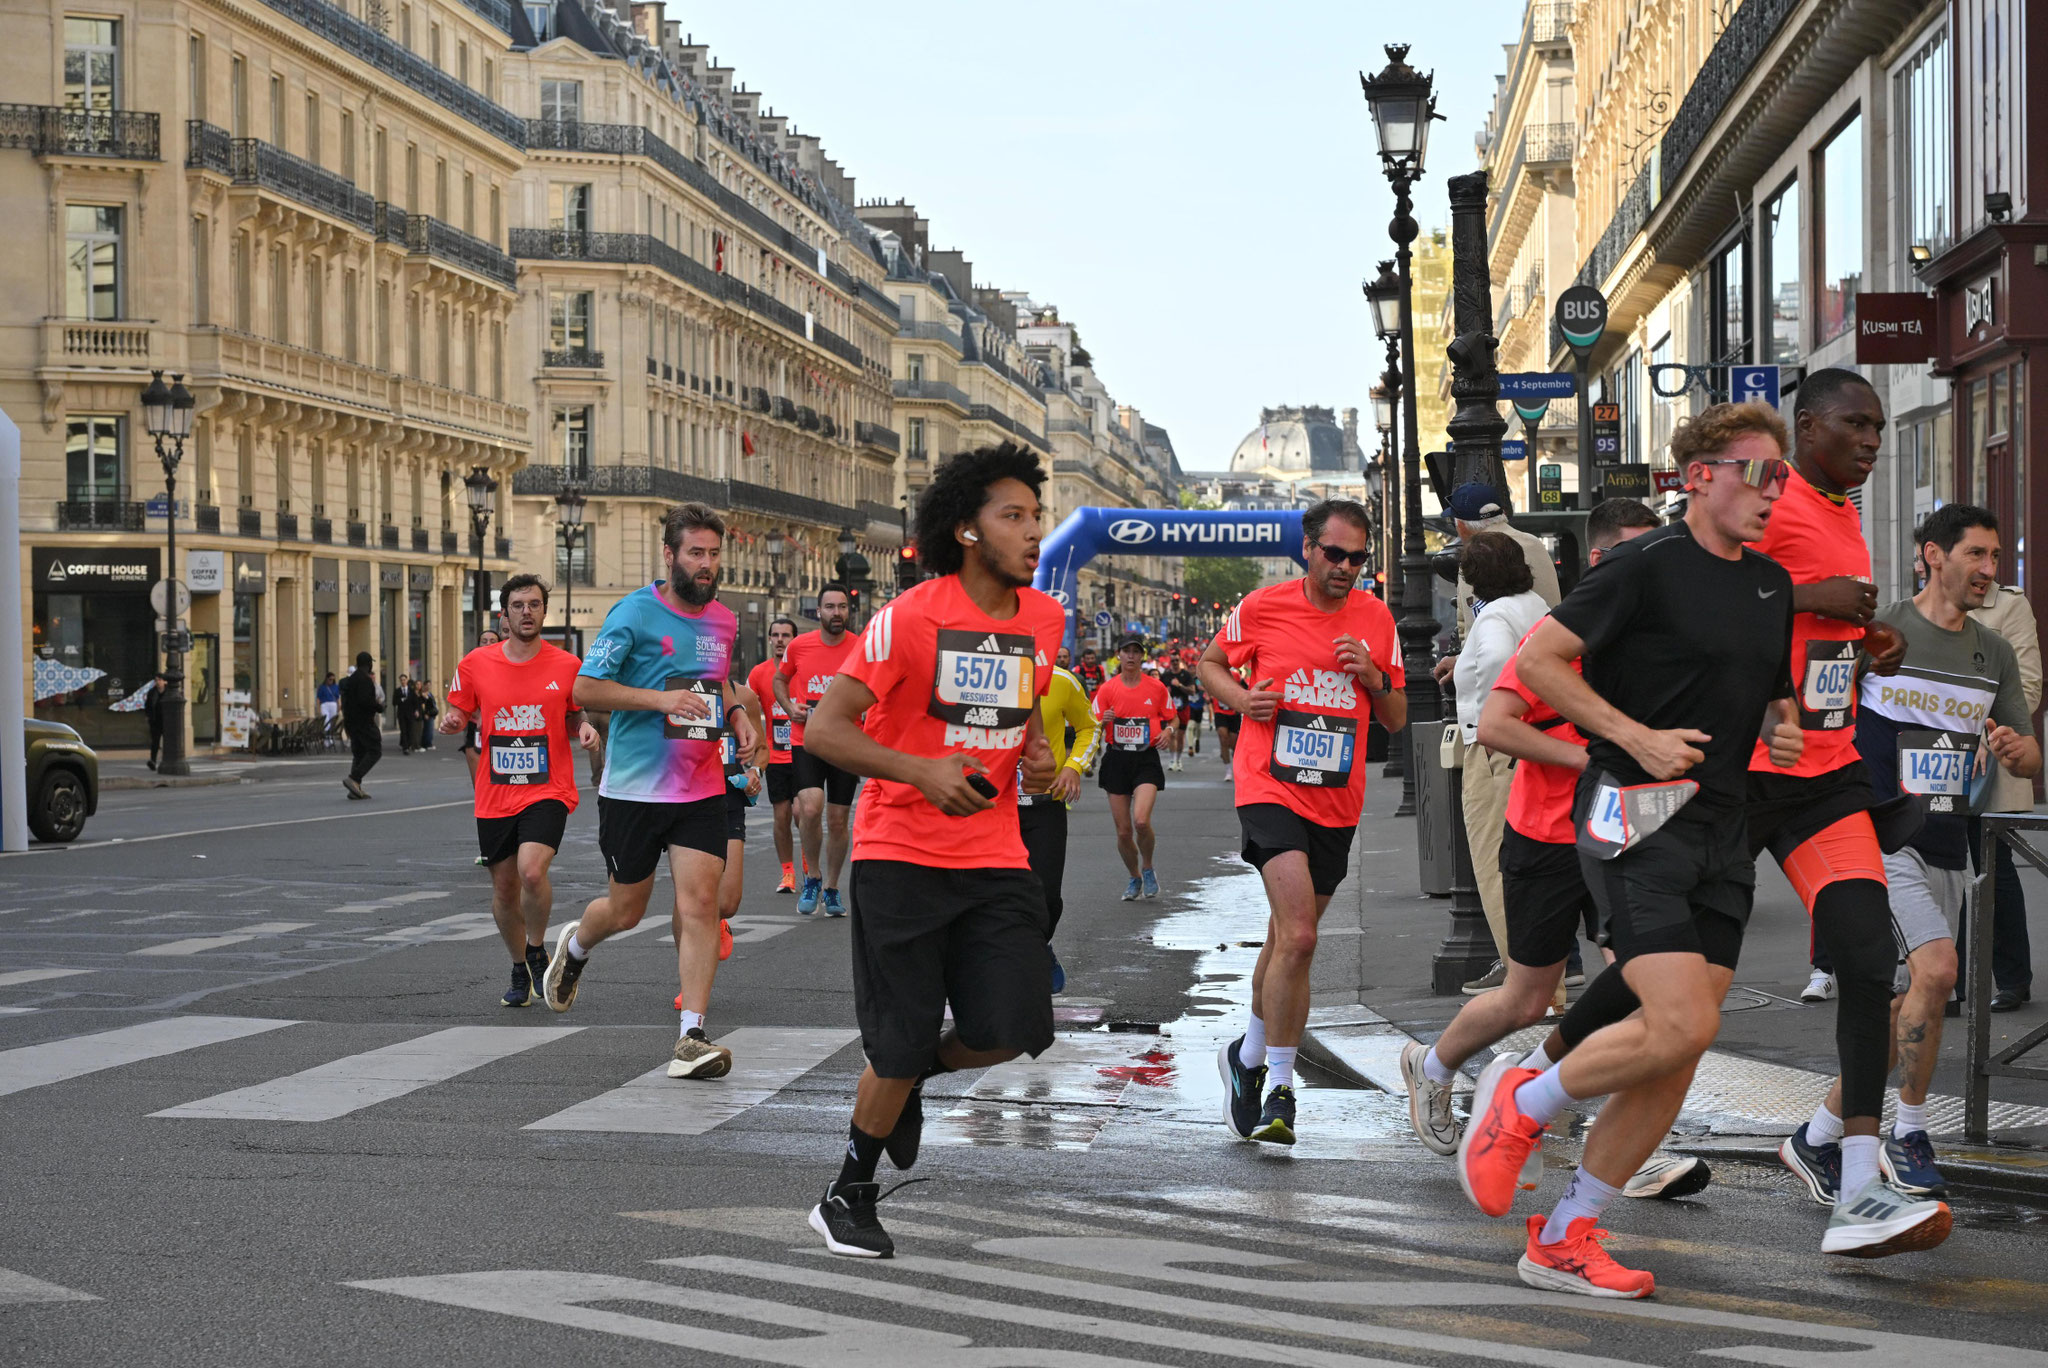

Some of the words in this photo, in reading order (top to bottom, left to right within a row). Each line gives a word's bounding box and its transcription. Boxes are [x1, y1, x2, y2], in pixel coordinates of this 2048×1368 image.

[1564, 300, 1600, 319] BUS
[1862, 320, 1898, 335] KUSMI
[1901, 320, 1923, 335] TEA
[1512, 381, 1519, 389] 4
[1521, 380, 1571, 392] Septembre
[1597, 406, 1615, 420] 27
[1597, 438, 1616, 452] 95
[1543, 467, 1557, 477] 21
[1543, 491, 1559, 502] 68
[1162, 523, 1281, 543] HYUNDAI
[67, 564, 110, 575] COFFEE
[111, 564, 148, 575] HOUSE
[954, 655, 1007, 691] 5576
[1313, 669, 1357, 690] 10K
[959, 691, 999, 704] NESSWESS
[1284, 683, 1357, 710] PARIS
[1881, 686, 1940, 713] PARIS
[511, 704, 546, 720] 10K
[978, 707, 999, 721] 10K
[494, 717, 546, 731] PARIS
[963, 713, 999, 727] PARIS
[1824, 715, 1844, 728] PARIS
[687, 731, 708, 740] PARIS
[944, 722, 1026, 750] PARIS
[1116, 726, 1141, 738] 18009
[1286, 729, 1335, 759] 13051
[496, 751, 535, 769] 16735
[1298, 757, 1318, 767] YOANN
[1910, 752, 1960, 781] 14273
[1296, 773, 1323, 785] PARIS
[1929, 782, 1948, 792] NICKO
[1929, 799, 1953, 812] PARIS
[1939, 795, 1953, 805] 10K
